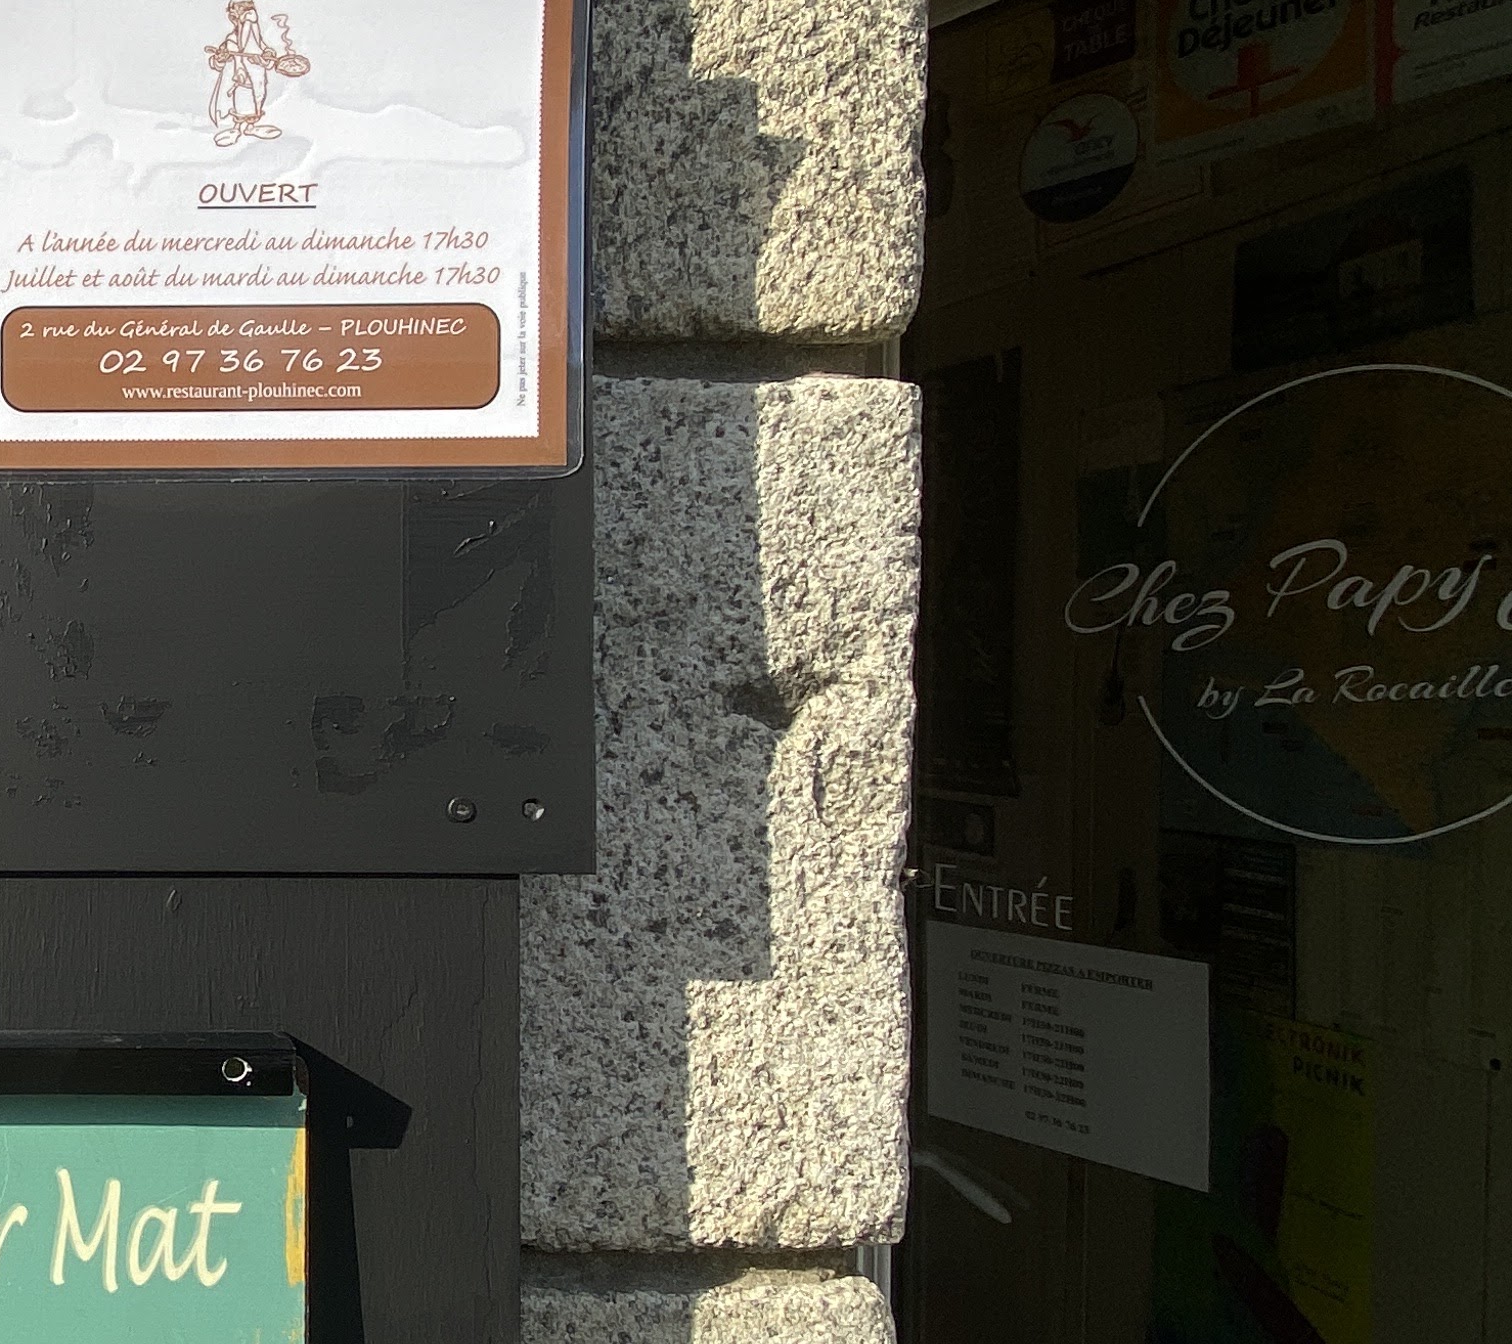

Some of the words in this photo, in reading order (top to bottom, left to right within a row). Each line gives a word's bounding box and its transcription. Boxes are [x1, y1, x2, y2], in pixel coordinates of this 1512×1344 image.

[198, 184, 318, 205] OUVERT
[17, 235, 35, 252] A
[42, 229, 118, 252] l'année
[124, 230, 157, 252] du
[161, 230, 261, 252] mercredi
[265, 236, 297, 251] au
[301, 230, 413, 251] dimanche
[424, 229, 489, 250] 17h30
[0, 268, 76, 293] Juillet
[82, 270, 102, 288] et
[108, 266, 159, 288] août
[164, 267, 197, 288] du
[201, 266, 272, 287] mardi
[276, 272, 309, 287] au
[313, 266, 426, 287] dimanche
[434, 265, 500, 286] 17h30
[21, 323, 35, 339] 2
[42, 325, 77, 337] rue
[82, 321, 116, 337] du
[120, 317, 202, 337] Général
[207, 319, 234, 337] de
[239, 318, 312, 337] Gaulle
[340, 317, 467, 336] PLOUHINEC
[99, 350, 146, 374] 02
[161, 349, 202, 374] 97
[219, 350, 264, 373] 36
[282, 349, 324, 372] 76
[338, 349, 383, 372] 23
[122, 382, 362, 402] www.restaurant-plouhinec.com
[517, 393, 526, 407] Ne
[1064, 559, 1237, 652] Chez
[1266, 538, 1493, 636] Papy
[1196, 675, 1242, 720] by
[1254, 667, 1318, 708] La
[934, 862, 1074, 931] ENTRÉE
[48, 1167, 243, 1291] Mat
